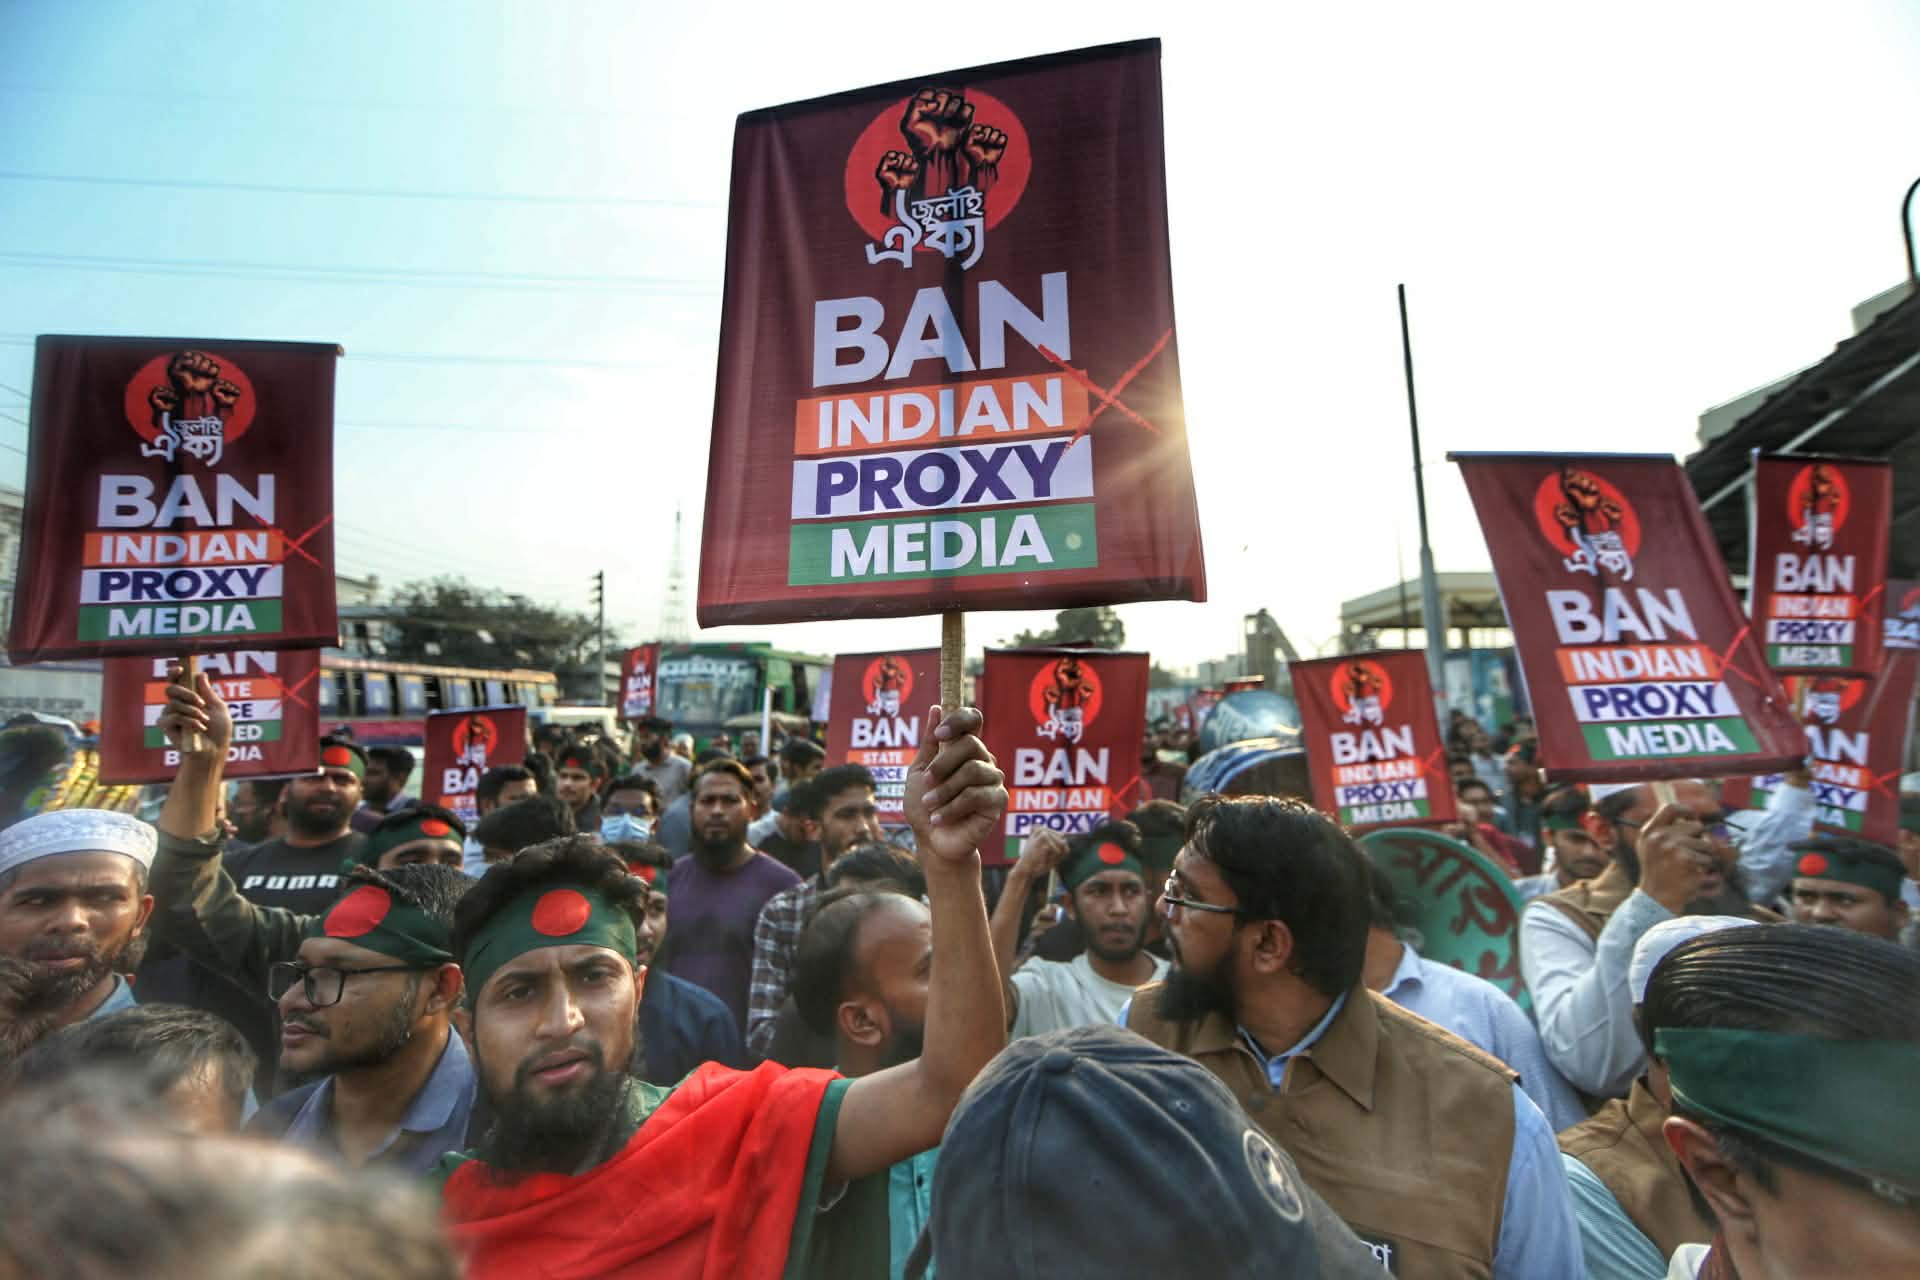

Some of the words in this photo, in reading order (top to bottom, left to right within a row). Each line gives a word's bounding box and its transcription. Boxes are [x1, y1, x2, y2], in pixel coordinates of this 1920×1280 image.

[911, 185, 984, 226] জুলাই
[865, 189, 985, 270] ঐক্য
[812, 271, 1072, 388] BAN
[817, 378, 1064, 449] INDIAN
[815, 441, 1069, 515] PROXY
[97, 473, 276, 528] BAN
[100, 533, 268, 564] INDIAN
[830, 513, 1054, 578] MEDIA
[100, 565, 270, 601] PROXY
[1774, 553, 1856, 593] BAN
[108, 604, 257, 637] MEDIA
[1545, 587, 1699, 644] BAN
[1775, 595, 1849, 617] INDIAN
[1776, 621, 1848, 641] PROXY
[1569, 647, 1709, 681] INDIAN
[1778, 646, 1842, 666] MEDIA
[1581, 684, 1717, 718] PROXY
[851, 715, 919, 748] BAN
[1330, 724, 1416, 765] BAN
[1605, 723, 1738, 756] MEDIA
[863, 752, 903, 764] STATE
[1014, 748, 1110, 786] BAN
[1339, 759, 1416, 784] INDIAN
[443, 767, 489, 795] BA
[1344, 780, 1416, 804] PROXY
[1015, 789, 1103, 810] INDIAN
[1352, 801, 1419, 824] MEDIA
[243, 875, 339, 890] PUMA
